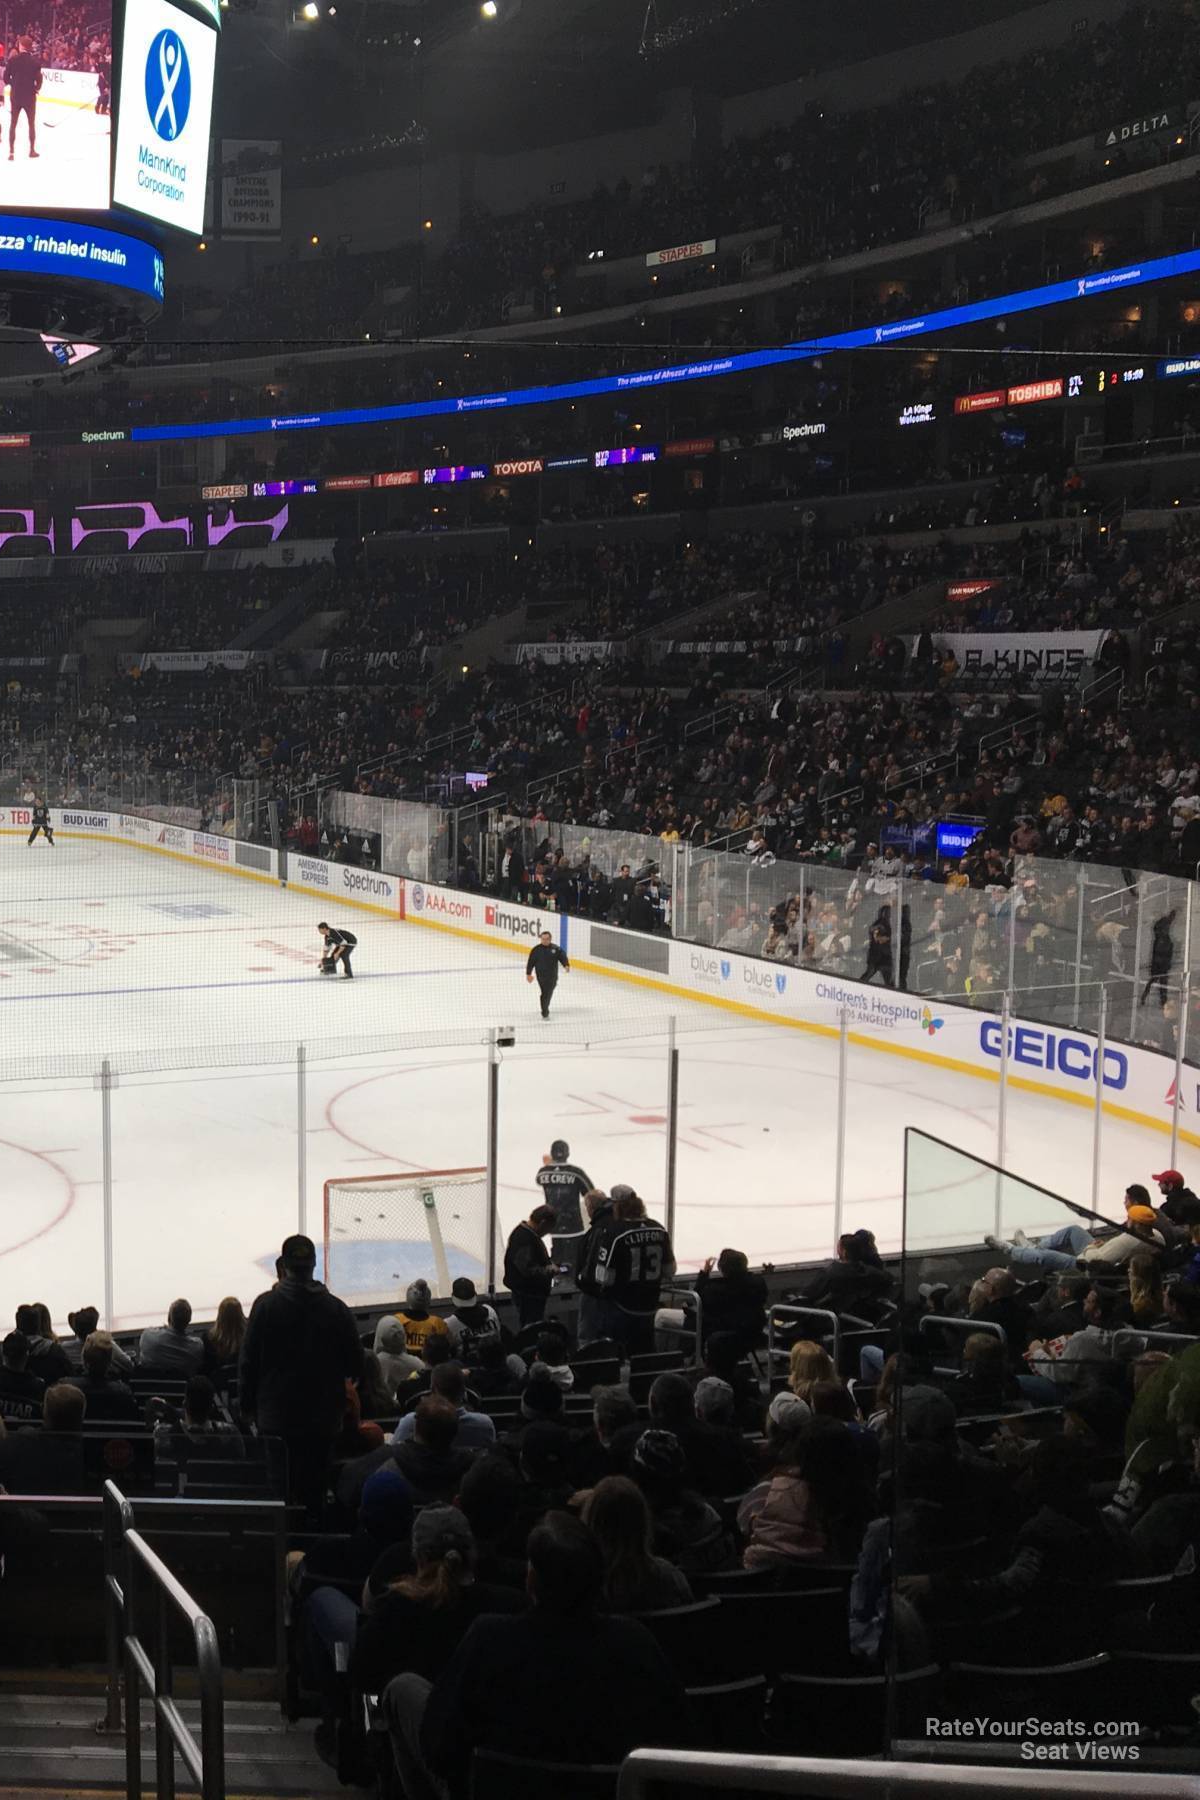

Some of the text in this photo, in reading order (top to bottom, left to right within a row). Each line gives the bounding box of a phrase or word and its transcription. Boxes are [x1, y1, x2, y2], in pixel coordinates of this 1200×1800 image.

[1121, 113, 1169, 141] DELTA
[138, 144, 186, 182] MannKind
[137, 169, 185, 203] Corporation
[228, 199, 275, 208] CHAMPIONS
[33, 235, 87, 258] inhaled
[90, 243, 127, 267] insulin
[659, 243, 703, 264] STAPLES
[1165, 363, 1185, 374] BUD
[1069, 375, 1084, 386] STL
[1008, 384, 1062, 403] TOSHIBA
[1068, 386, 1080, 397] LA
[903, 403, 933, 416] LA Kings
[82, 430, 125, 443] Spectrum
[783, 422, 825, 441] Spectrum
[641, 453, 656, 462] NHL
[470, 470, 485, 480] NHL
[494, 460, 543, 475] TOYOTA
[203, 485, 246, 498] STAPLES
[303, 484, 317, 493] NHL
[994, 649, 1085, 668] KINGS
[63, 814, 109, 828] BUD LIGHT
[942, 834, 961, 846] BUD
[297, 858, 329, 874] AMERICAN
[301, 870, 329, 886] EXPRESS
[343, 869, 388, 896] Spectrum
[425, 893, 472, 918] AAA.com
[690, 953, 719, 975] blue
[743, 965, 773, 988] blue
[815, 982, 922, 1021] Children's Hospital
[858, 1010, 895, 1028] ANGELES
[980, 1020, 1128, 1091] GEICO
[551, 1174, 576, 1185] CREW
[629, 1244, 663, 1282] 13
